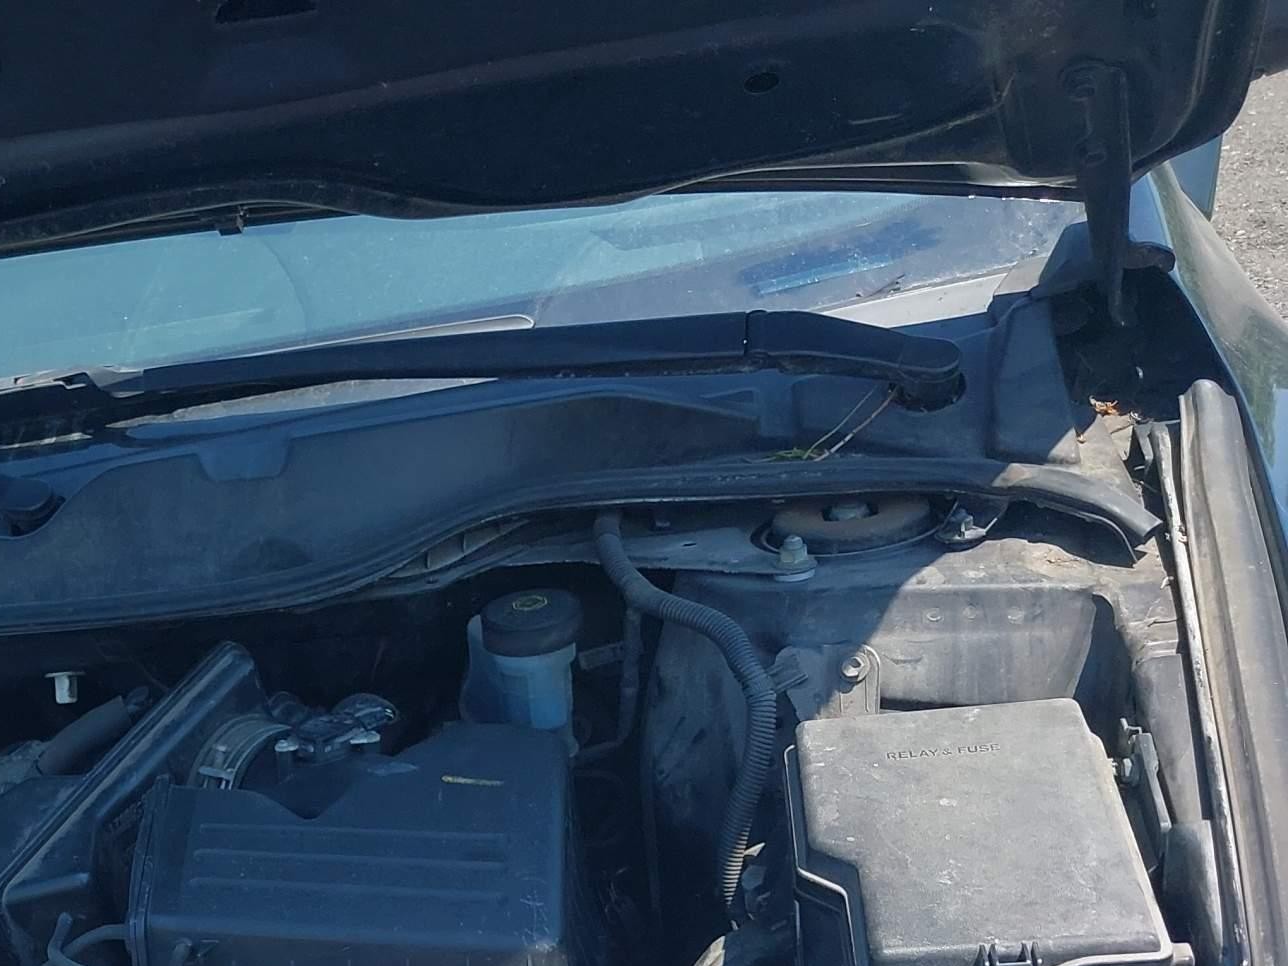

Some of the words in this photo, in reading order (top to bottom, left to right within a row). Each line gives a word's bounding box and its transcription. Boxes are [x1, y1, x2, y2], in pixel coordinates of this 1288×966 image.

[886, 748, 938, 760] RELAY
[942, 747, 952, 756] &
[958, 743, 1001, 753] FUSE
